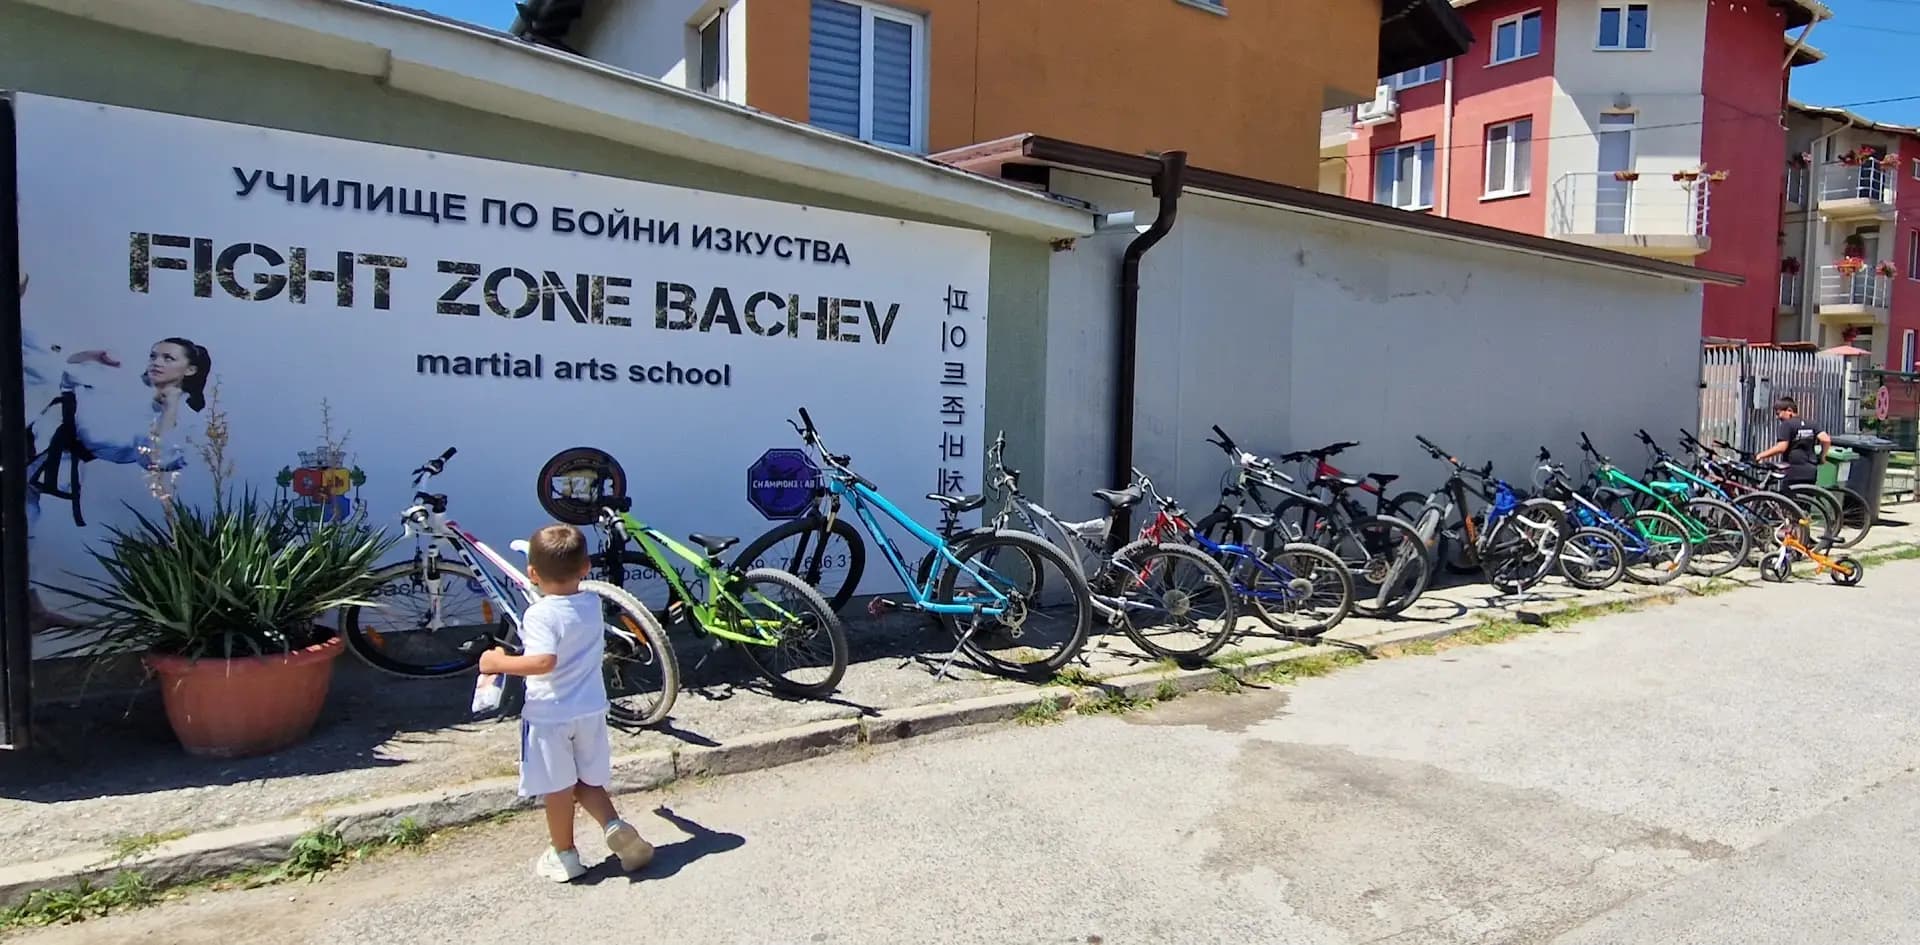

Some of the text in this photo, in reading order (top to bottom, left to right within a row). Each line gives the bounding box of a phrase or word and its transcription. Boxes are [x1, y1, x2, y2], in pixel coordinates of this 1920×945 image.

[232, 166, 851, 266] УЧИЛИЩЕ ПО БОЙНИ ИЗКУСТВА
[129, 231, 901, 345] FIGHT ZONE BACHEV
[416, 352, 731, 387] martial arts school
